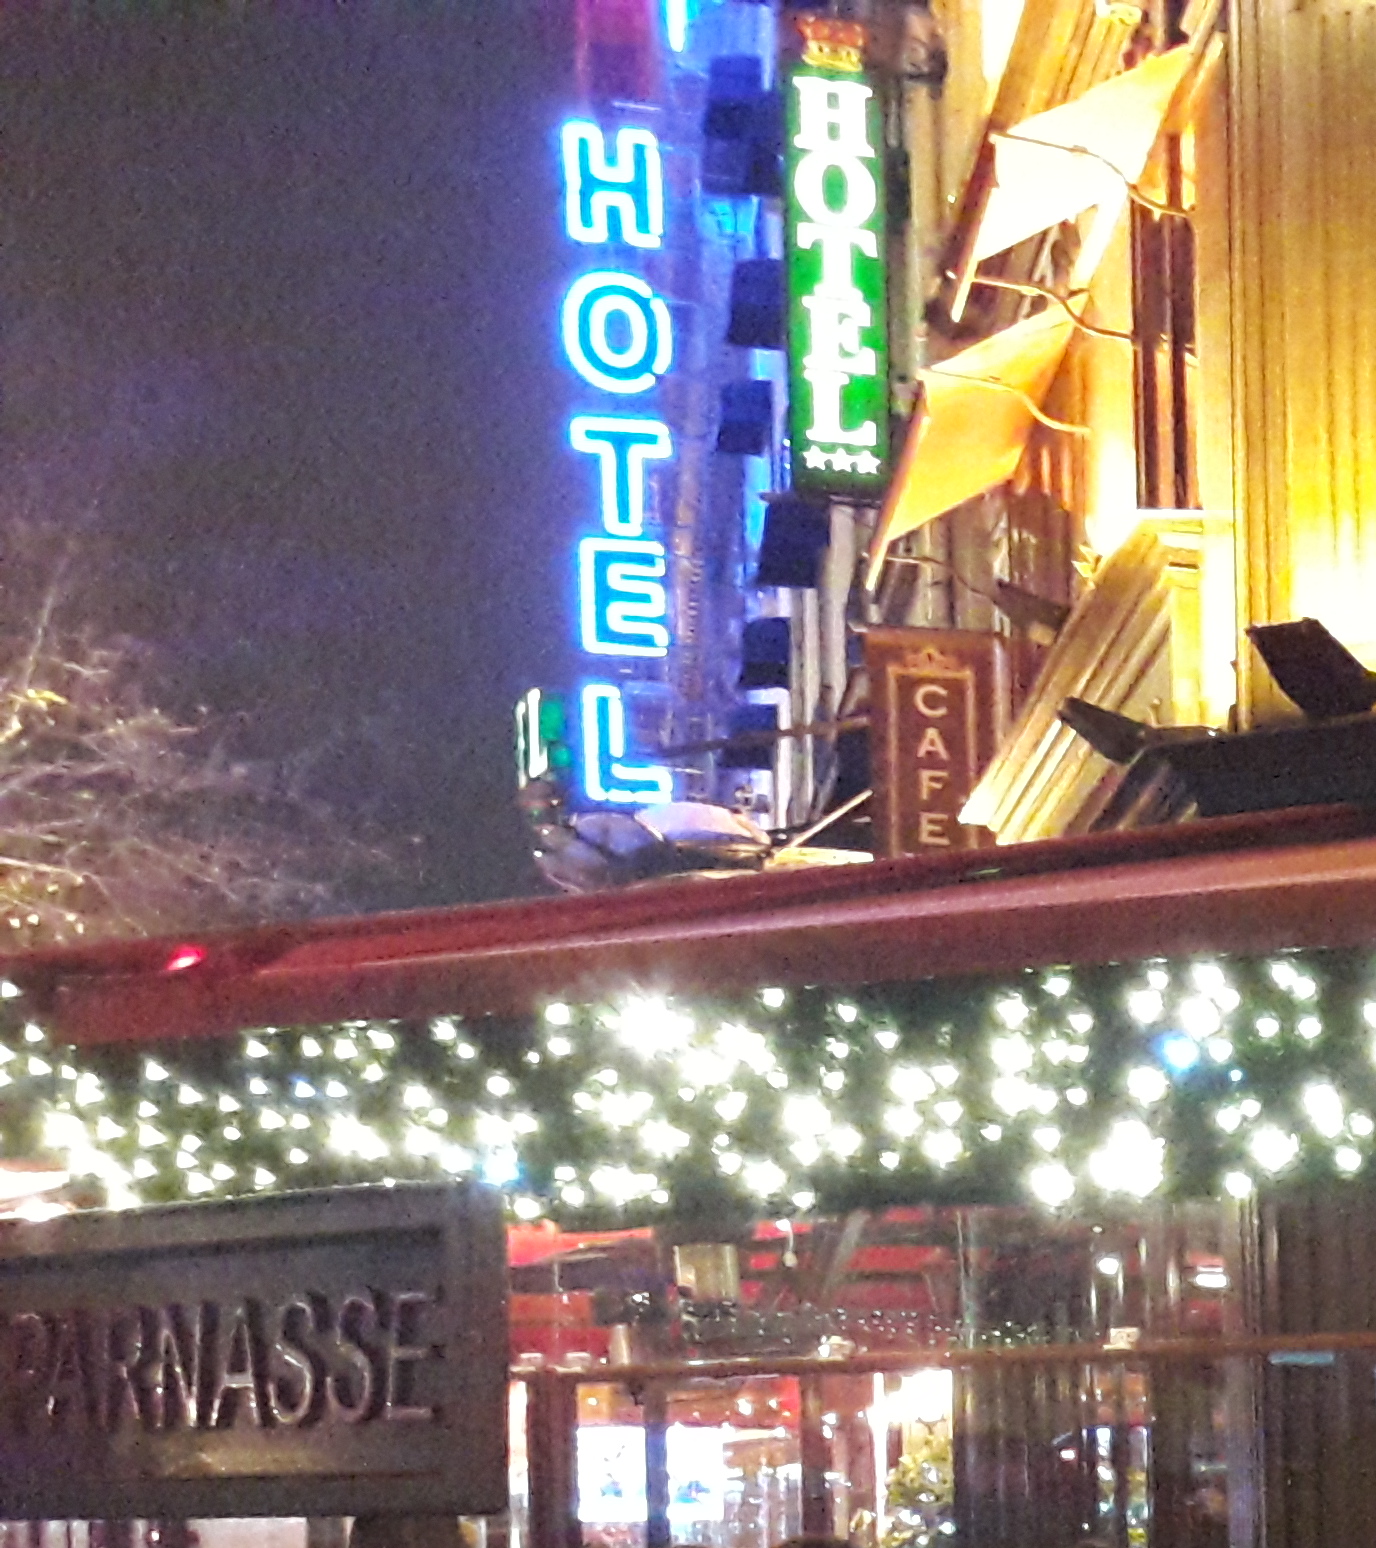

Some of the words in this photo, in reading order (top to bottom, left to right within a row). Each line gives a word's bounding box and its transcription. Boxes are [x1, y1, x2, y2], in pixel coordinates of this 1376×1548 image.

[792, 76, 878, 447] HOTEL
[562, 119, 673, 805] HOTEL
[914, 685, 951, 846] CAFE
